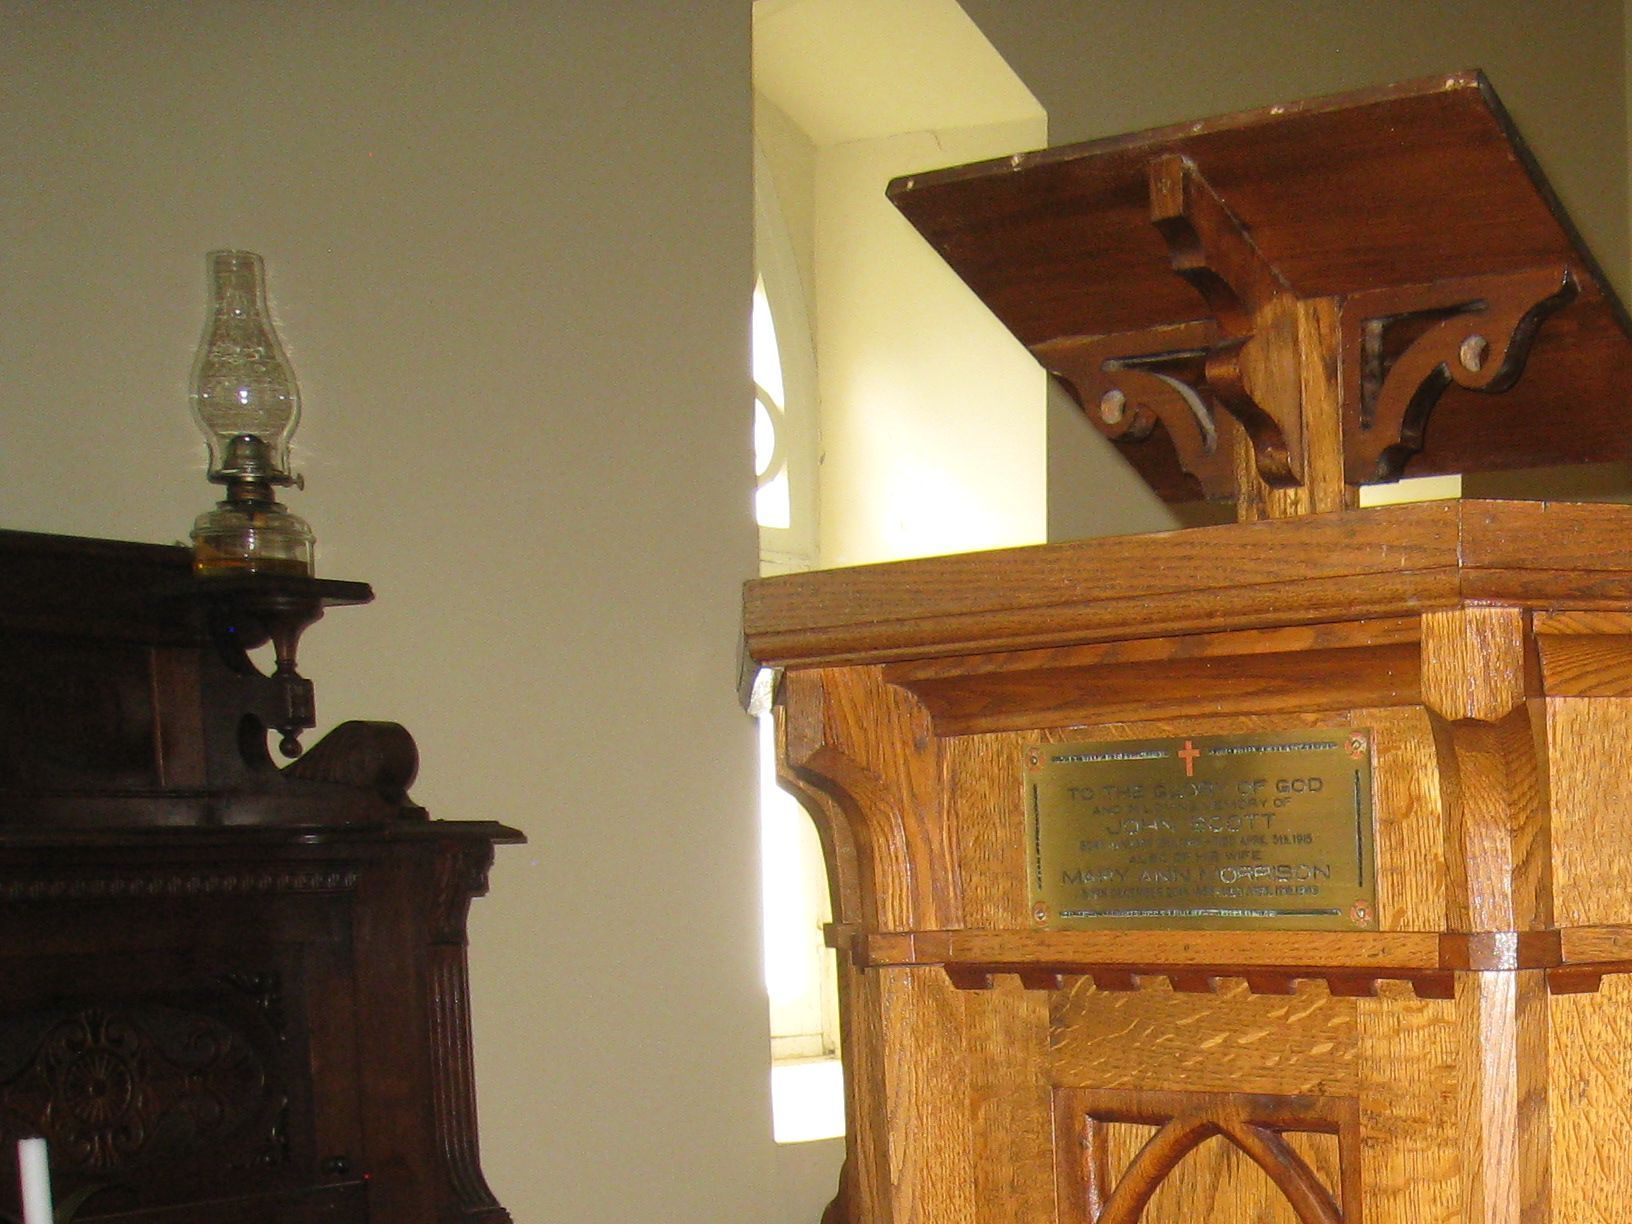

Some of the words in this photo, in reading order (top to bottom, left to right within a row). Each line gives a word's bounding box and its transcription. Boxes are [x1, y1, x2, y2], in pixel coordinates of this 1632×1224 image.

[1067, 786, 1094, 801] TO
[1102, 784, 1144, 800] THE
[1237, 779, 1267, 797] OF
[1276, 777, 1323, 794] GOD
[1273, 796, 1292, 808] OF
[1106, 817, 1175, 837] JOHN
[1191, 812, 1276, 834] SCOTT
[1225, 850, 1262, 861] WIFE
[1062, 867, 1130, 885] MARY
[1198, 863, 1331, 884] MORRISON
